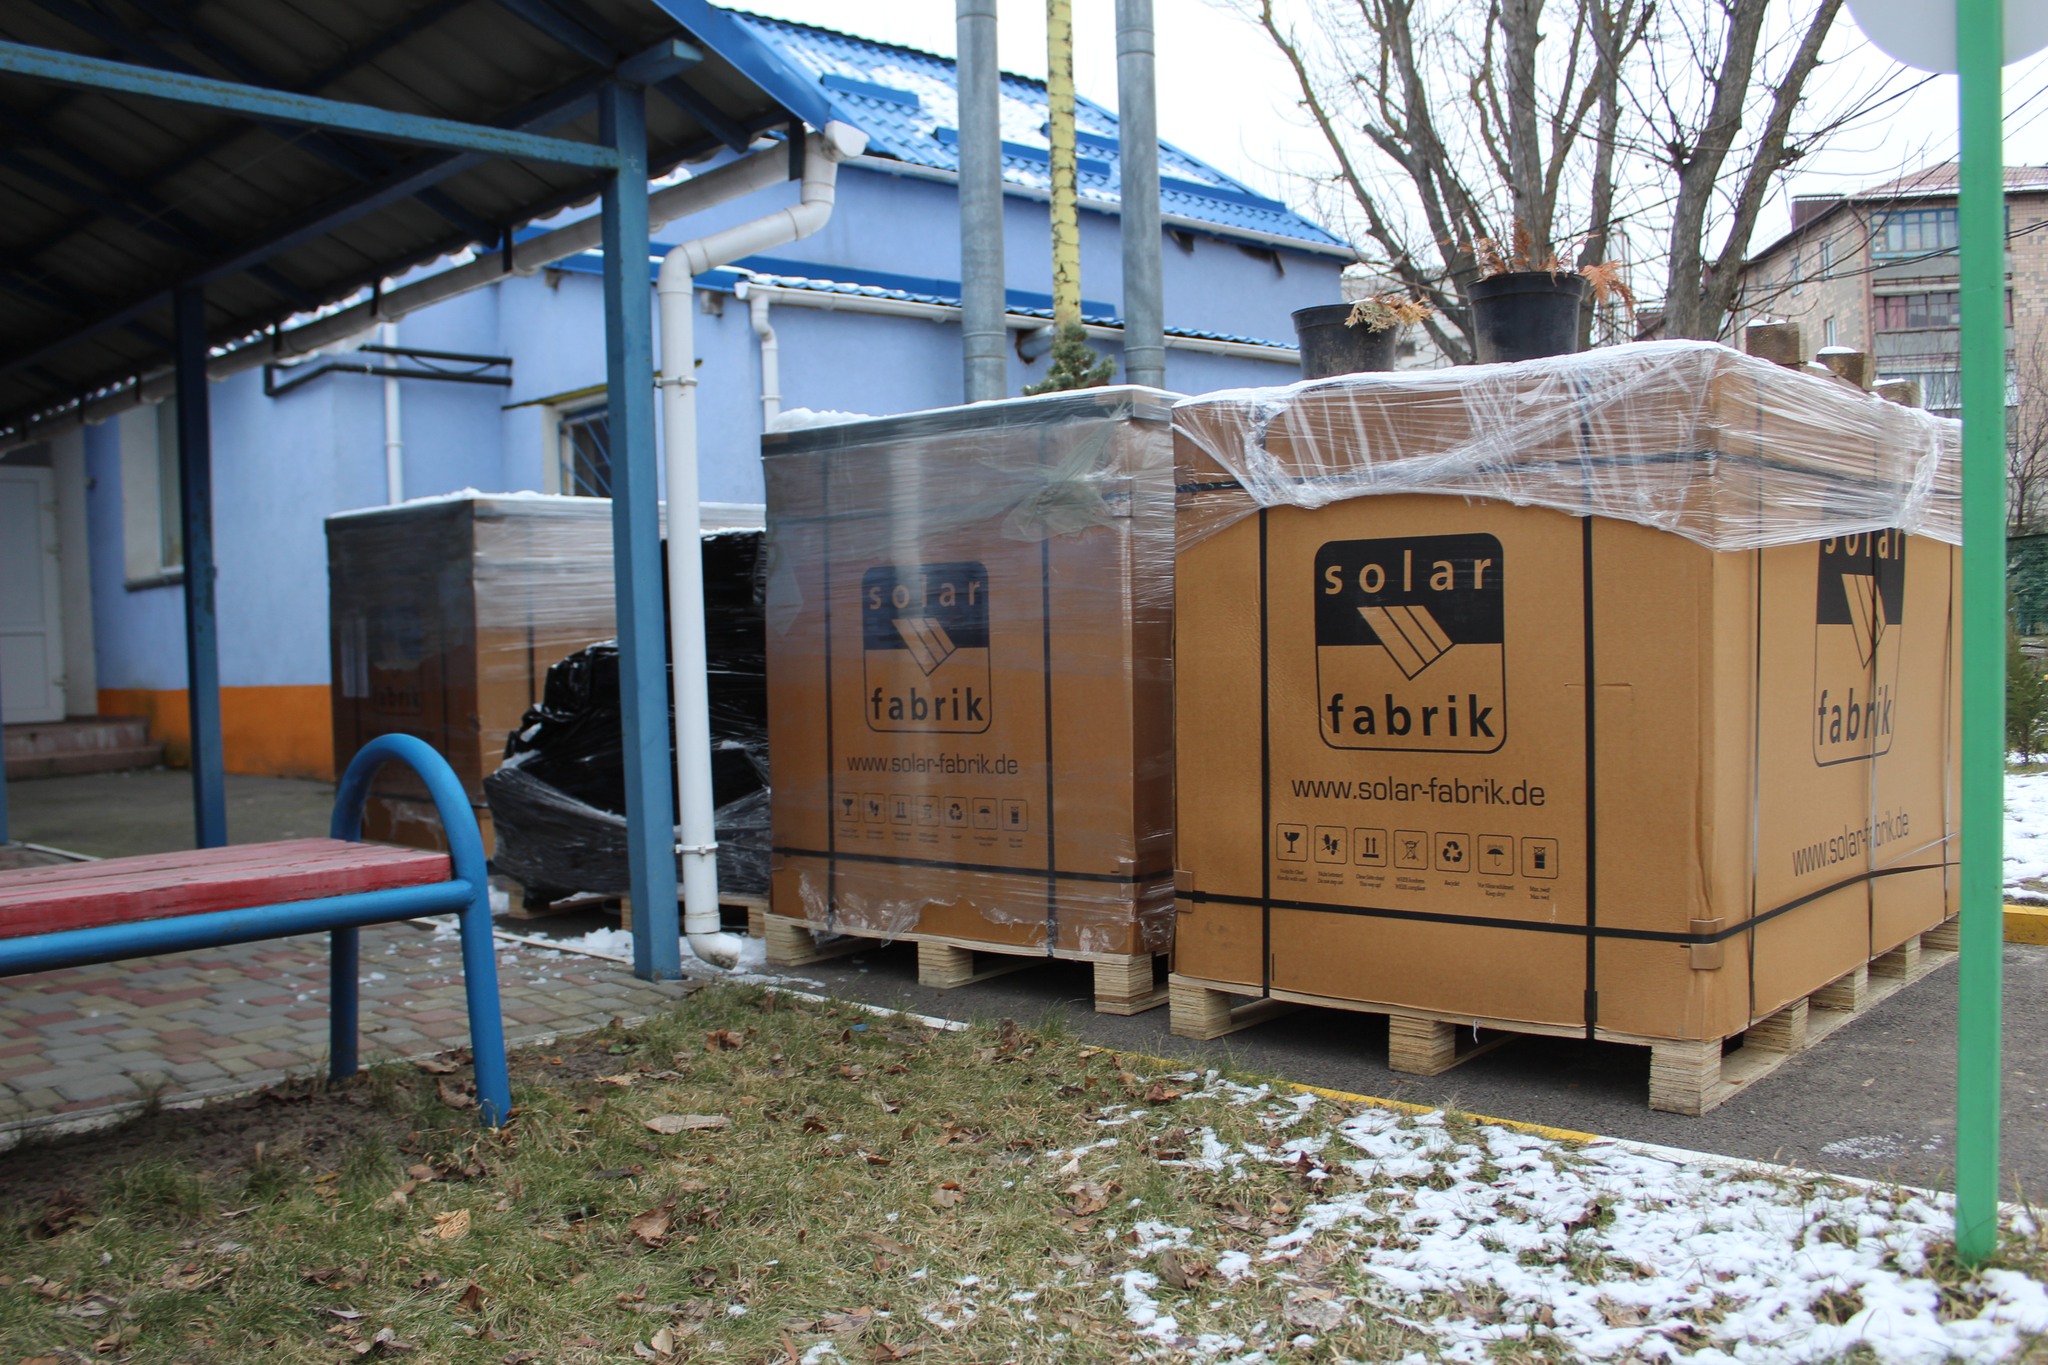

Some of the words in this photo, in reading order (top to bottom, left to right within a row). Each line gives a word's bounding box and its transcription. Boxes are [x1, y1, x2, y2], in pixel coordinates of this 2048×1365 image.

[1324, 549, 1492, 595] solar
[869, 573, 981, 610] solar
[871, 687, 984, 721] fabrik
[1327, 693, 1495, 738] fabrik
[1818, 684, 1892, 746] fabrik
[847, 752, 1018, 775] www.solar-fabrik.de
[1291, 775, 1546, 807] www.solar-fabrik.de
